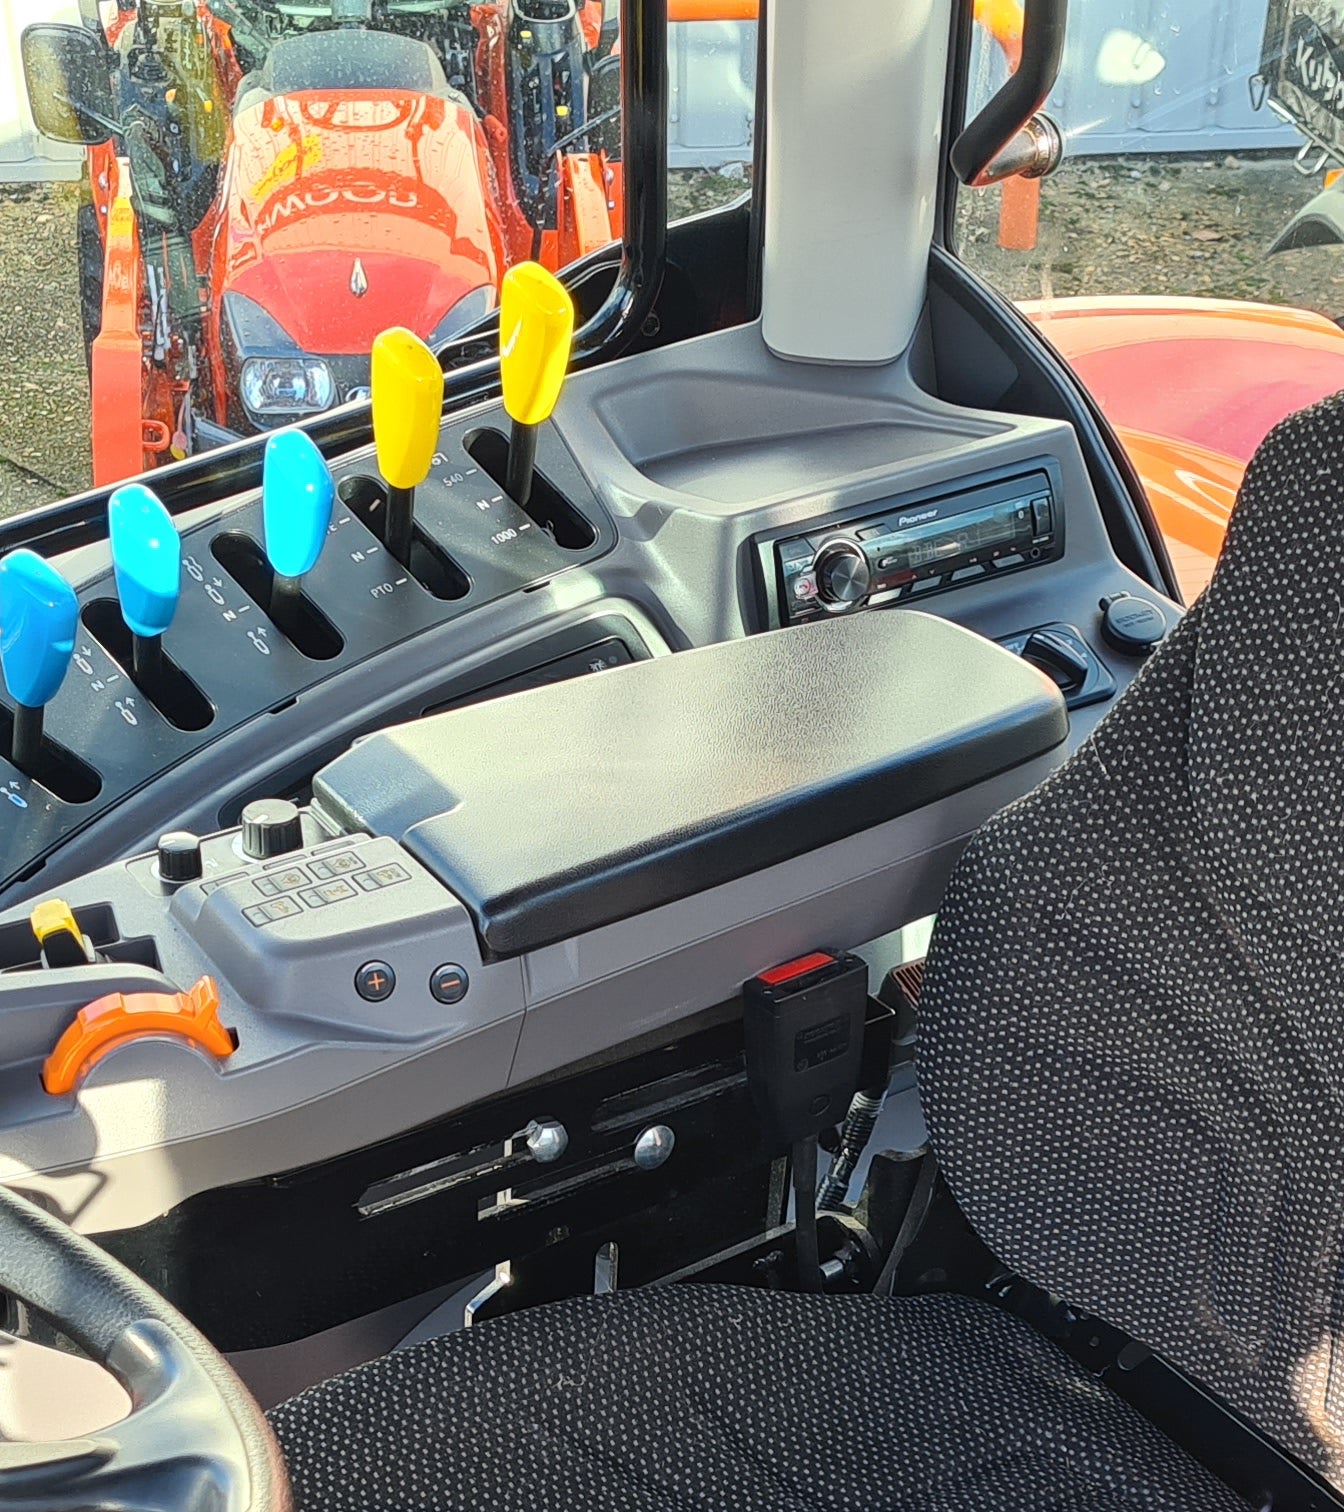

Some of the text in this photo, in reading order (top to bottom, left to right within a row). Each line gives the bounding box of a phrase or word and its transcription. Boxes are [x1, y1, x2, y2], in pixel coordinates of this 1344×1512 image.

[443, 472, 464, 488] 540
[475, 499, 491, 511] N
[898, 509, 939, 527] Pioneer
[490, 528, 517, 546] 1000
[350, 551, 365, 563] N
[369, 582, 394, 600] PTO
